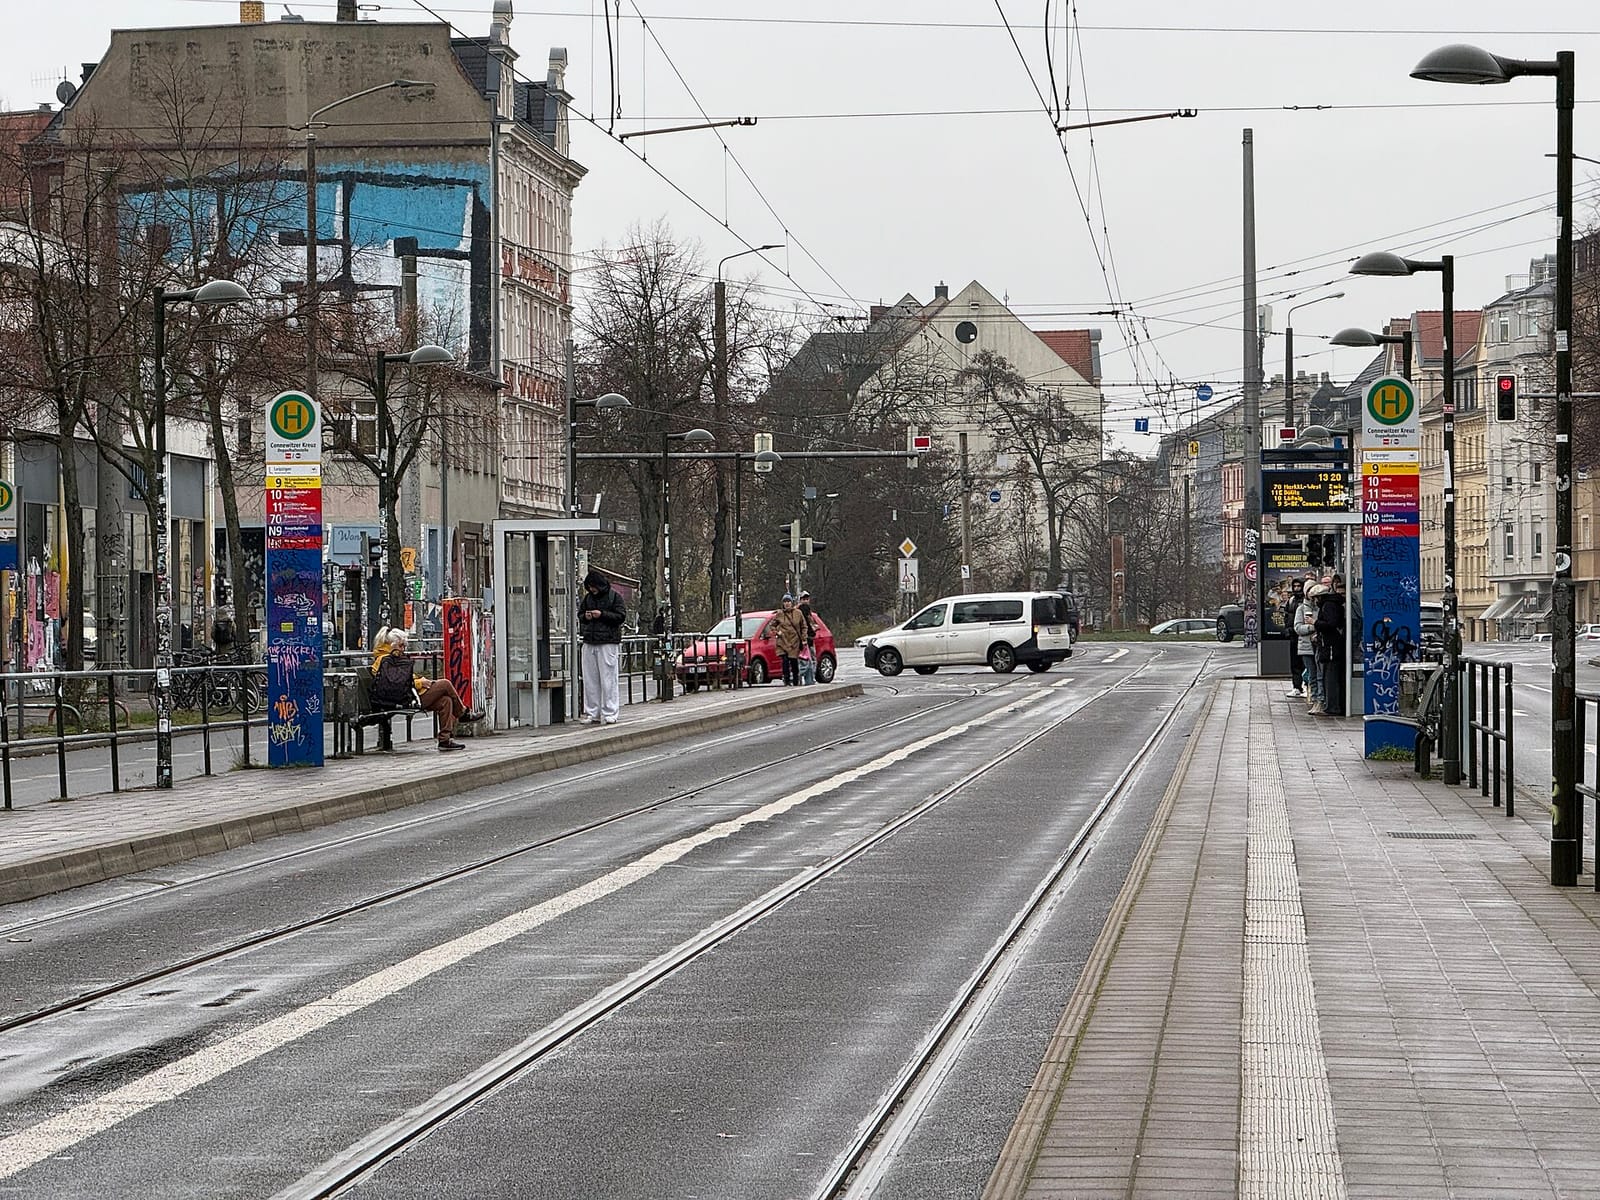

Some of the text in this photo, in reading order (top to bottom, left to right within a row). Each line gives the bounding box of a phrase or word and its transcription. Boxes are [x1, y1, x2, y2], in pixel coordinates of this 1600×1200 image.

[1381, 389, 1400, 415] H
[284, 405, 301, 429] H
[1138, 419, 1146, 430] T
[1372, 463, 1379, 474] 9
[275, 478, 282, 488] 9
[1318, 473, 1342, 482] 13 20
[1367, 476, 1379, 487] 10
[270, 490, 282, 500] 10
[1367, 488, 1379, 499] 11
[272, 502, 282, 512] 11
[1365, 501, 1378, 512] 70
[269, 514, 282, 524] 70
[1365, 513, 1380, 524] N9
[268, 526, 282, 536] N9
[1364, 525, 1380, 536] N10
[268, 645, 281, 654] THE
